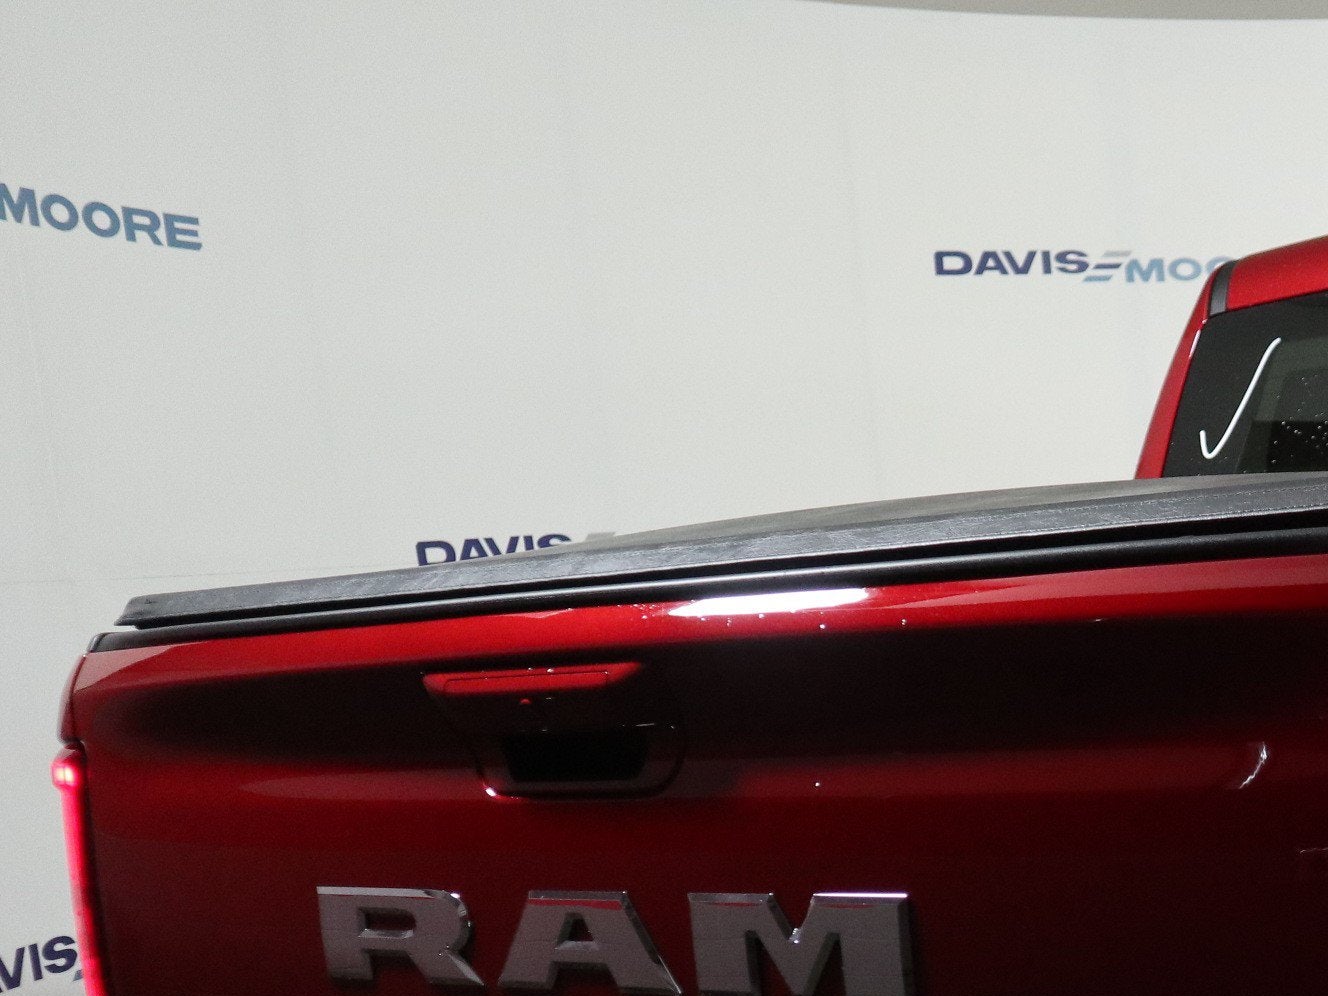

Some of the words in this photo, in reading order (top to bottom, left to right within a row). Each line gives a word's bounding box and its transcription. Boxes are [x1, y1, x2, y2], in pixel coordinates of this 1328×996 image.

[0, 182, 203, 251] MOORE
[933, 250, 1089, 276] DAVIS
[1124, 255, 1235, 283] MO
[0, 935, 78, 994] VIS
